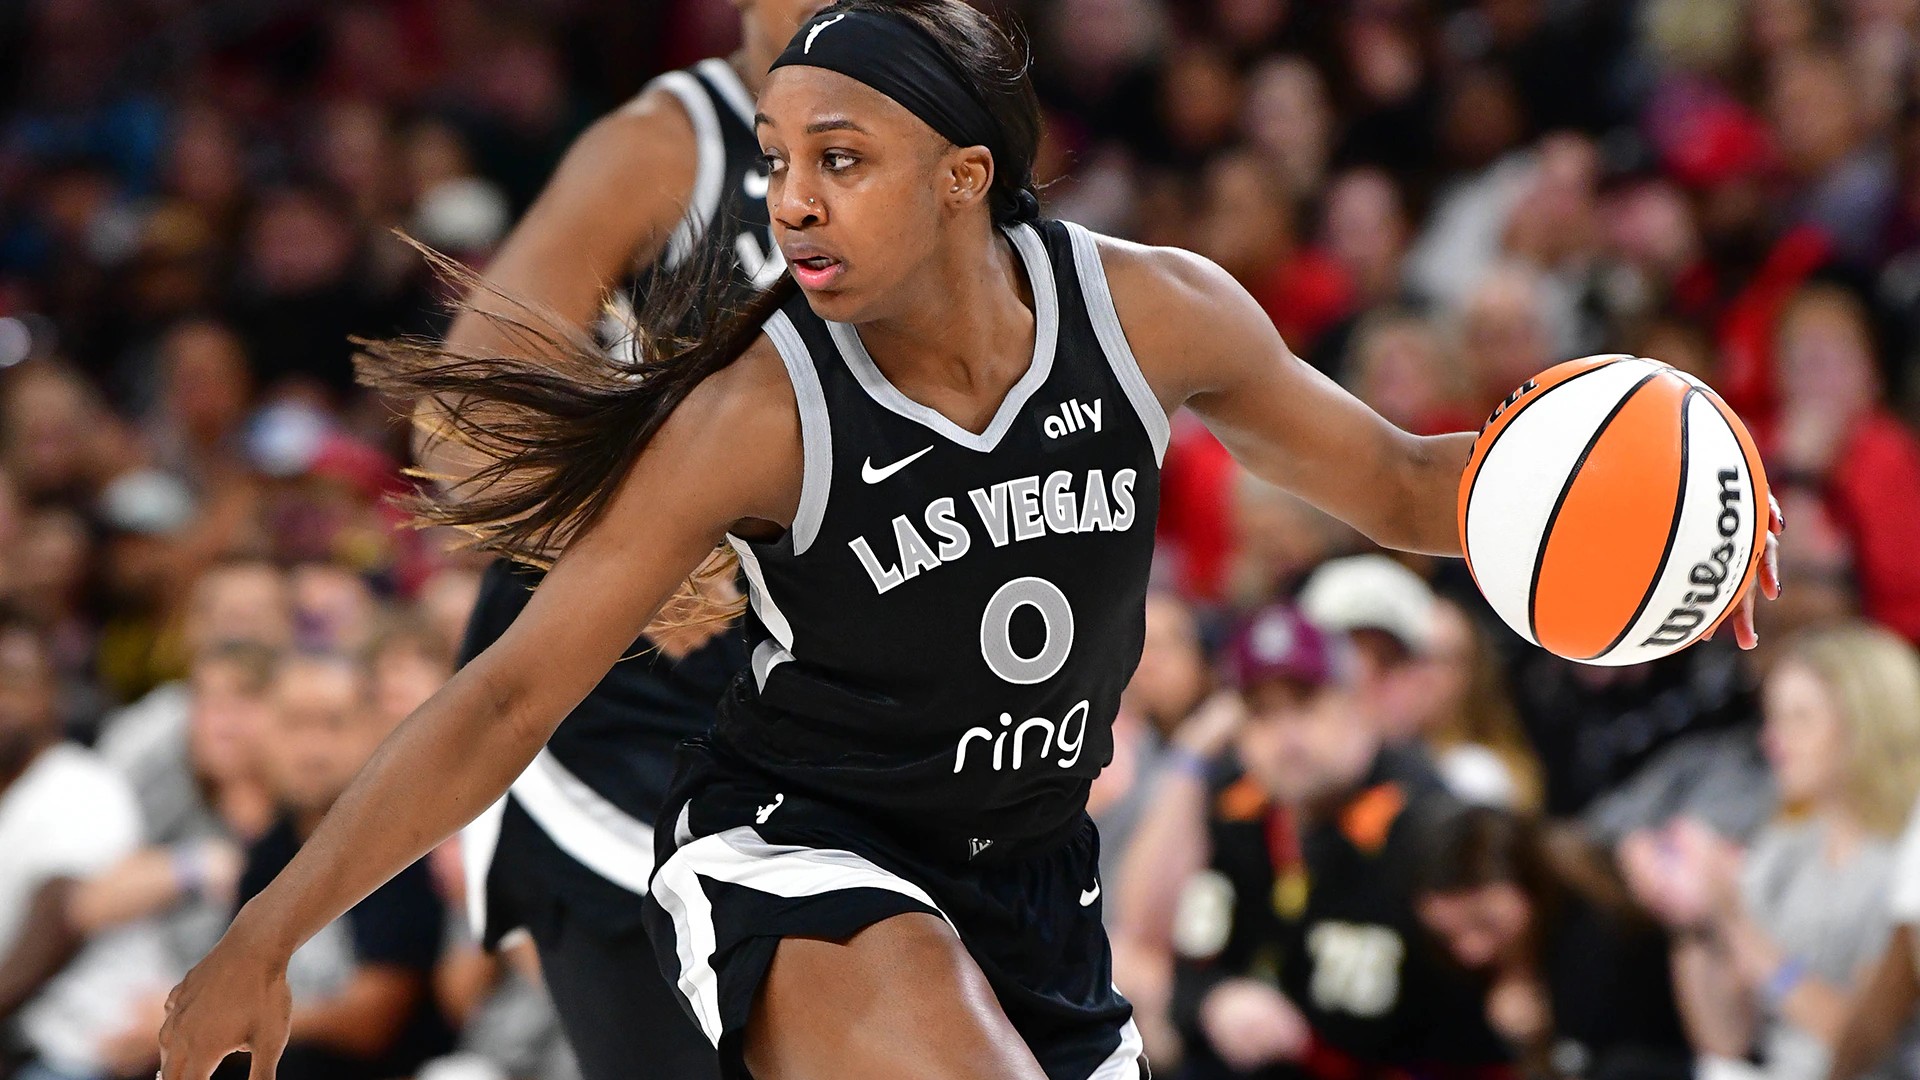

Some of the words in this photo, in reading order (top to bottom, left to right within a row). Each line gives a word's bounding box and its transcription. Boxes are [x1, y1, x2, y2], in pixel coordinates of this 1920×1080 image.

[1043, 398, 1102, 440] ally
[848, 497, 971, 594] LAS
[968, 468, 1136, 547] VEGAS
[1638, 465, 1742, 647] Wilson
[980, 576, 1074, 684] 0
[954, 699, 1089, 774] ring
